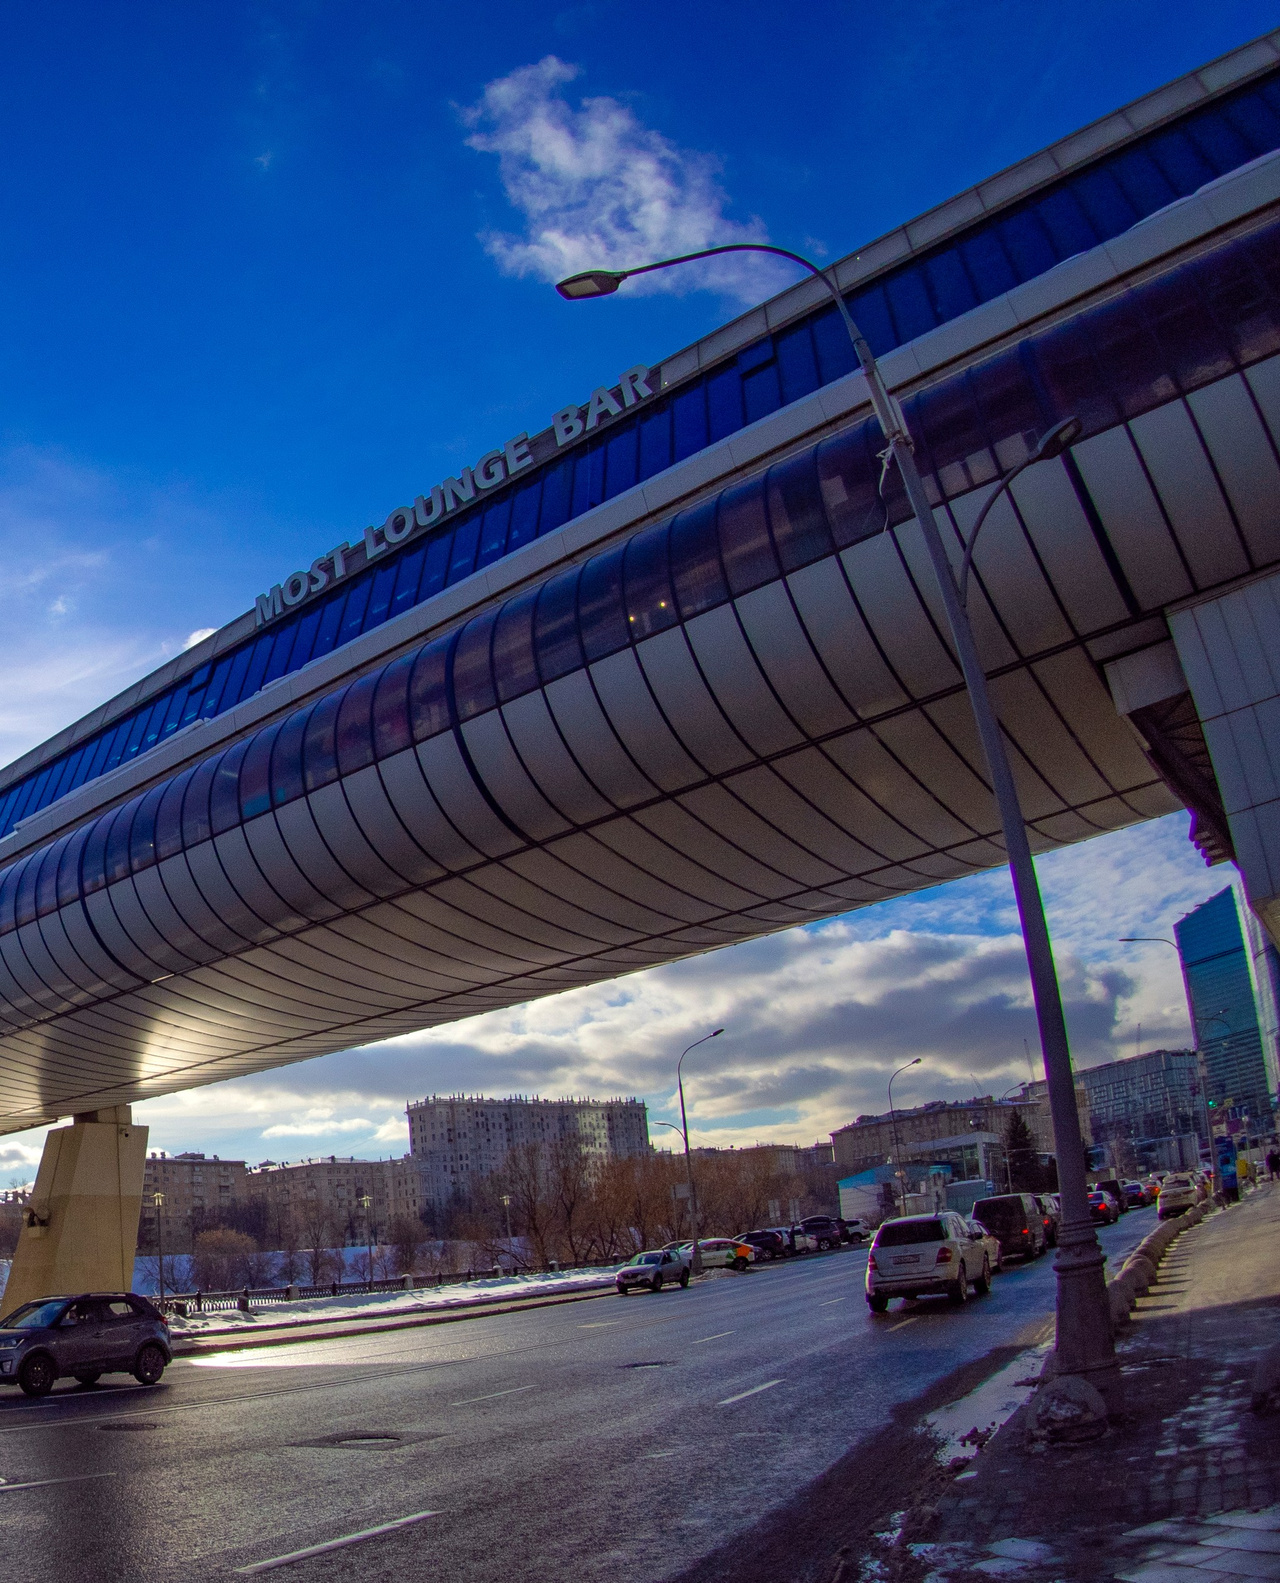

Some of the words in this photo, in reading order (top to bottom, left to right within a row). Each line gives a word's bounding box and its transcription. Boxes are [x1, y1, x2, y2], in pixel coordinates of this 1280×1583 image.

[255, 541, 354, 629] MOST
[363, 431, 535, 560] LOUNGE
[552, 364, 653, 447] BAR
